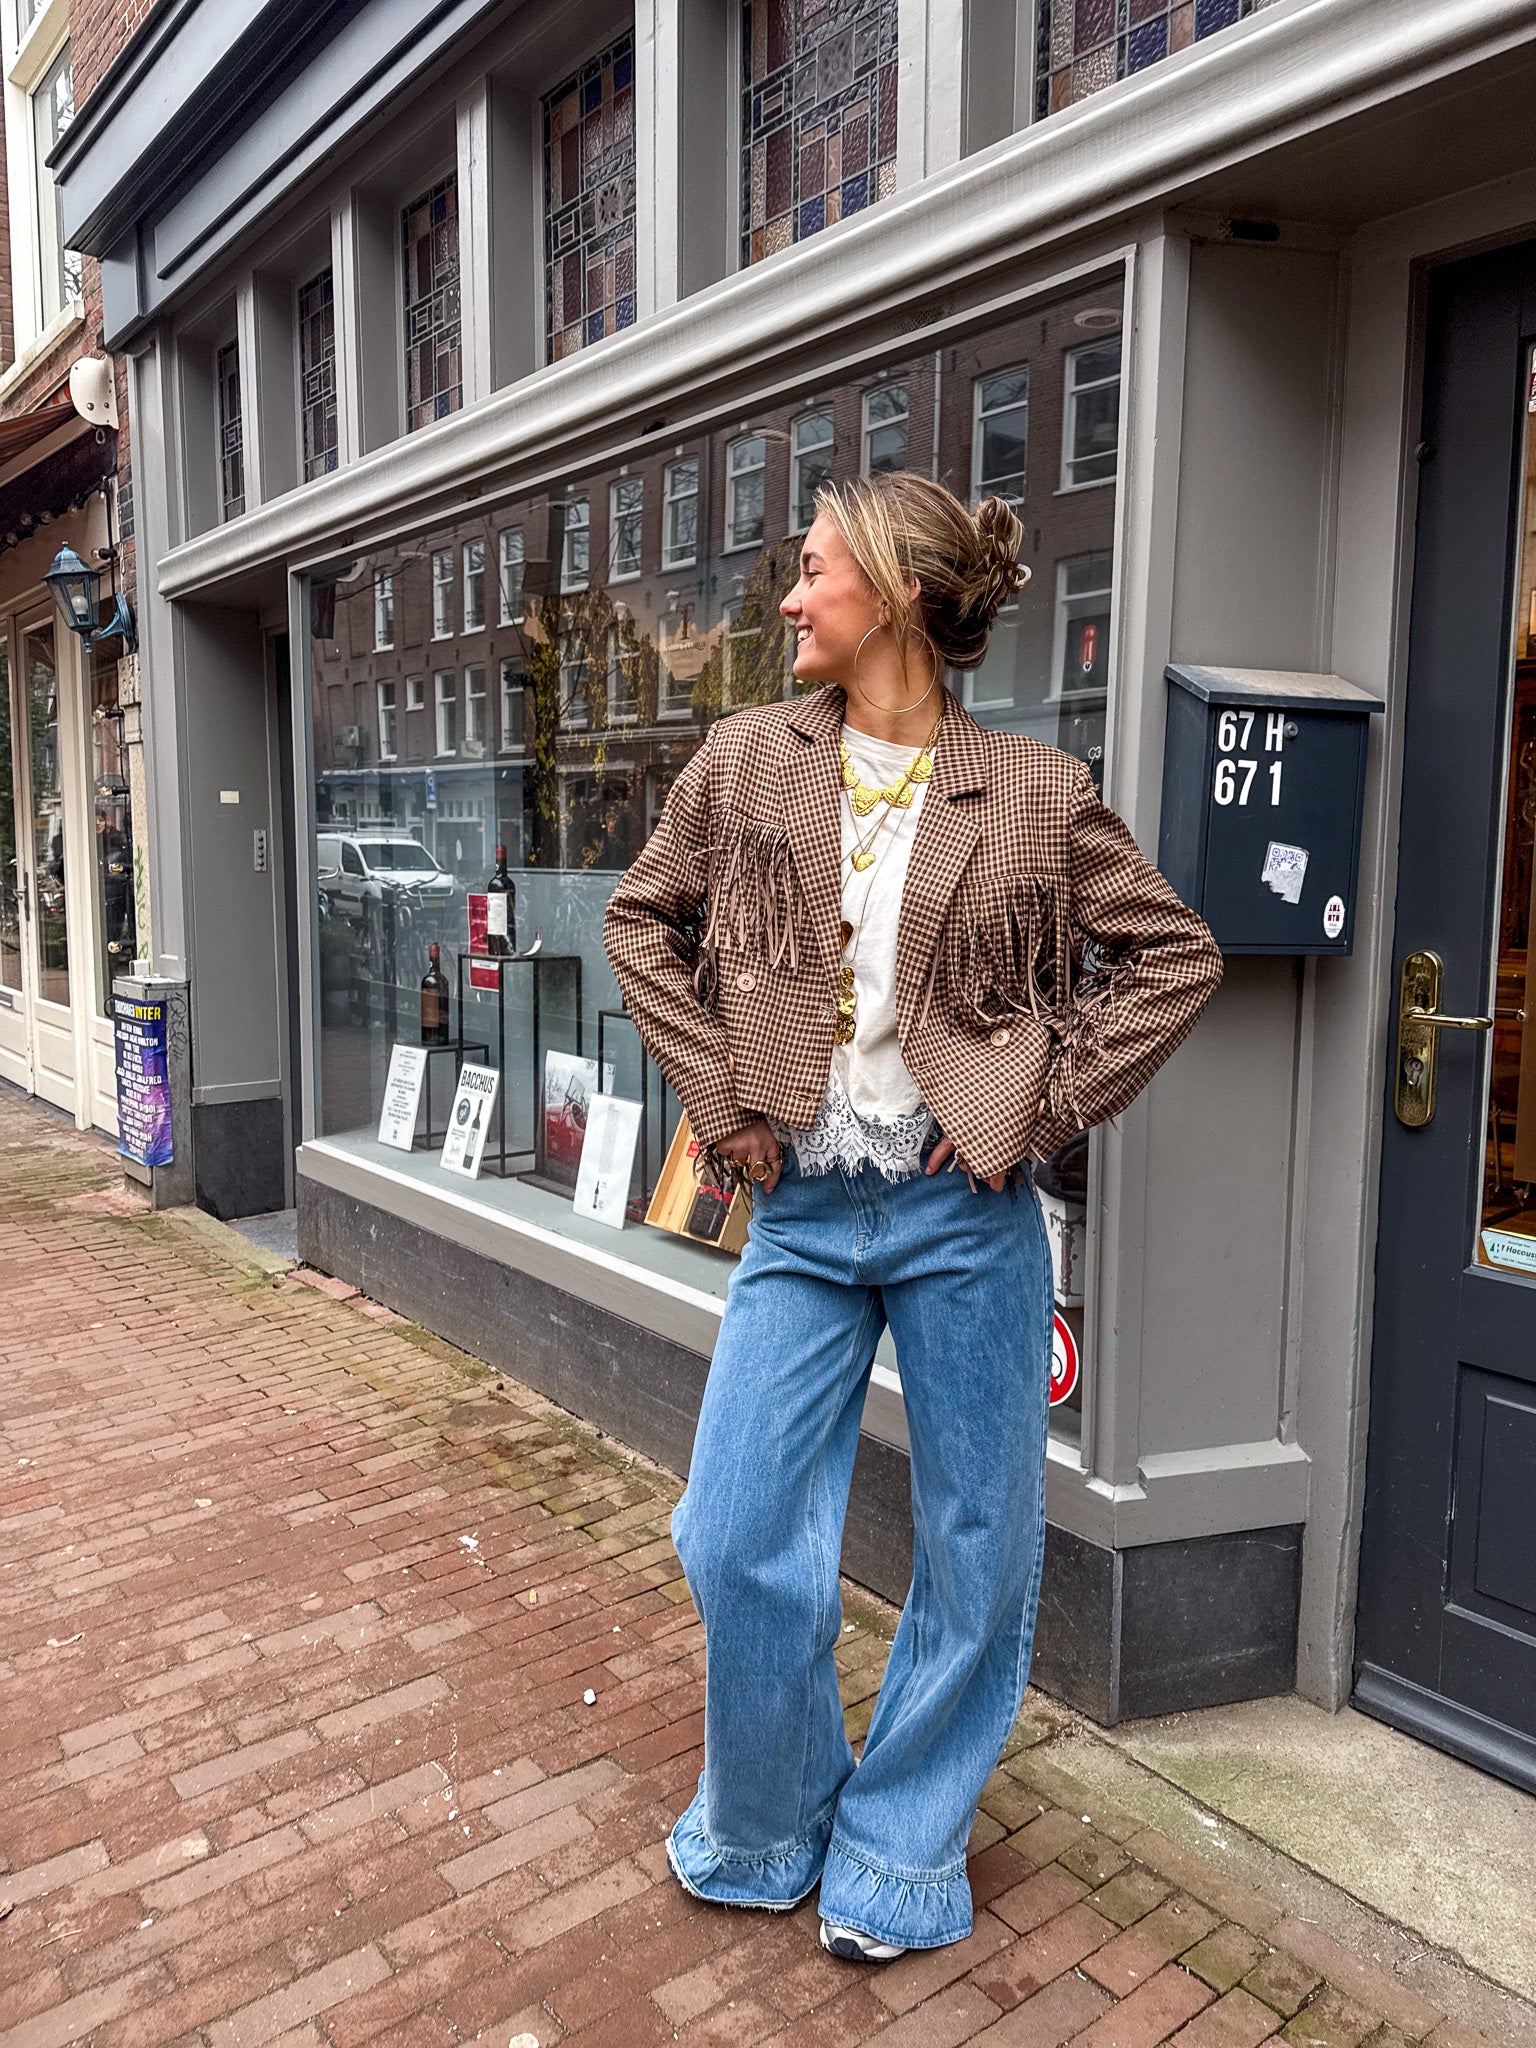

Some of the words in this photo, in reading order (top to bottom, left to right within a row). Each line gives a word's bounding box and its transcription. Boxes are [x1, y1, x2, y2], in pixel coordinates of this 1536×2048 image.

[1218, 710, 1255, 752] 67
[1265, 712, 1285, 752] H
[1214, 759, 1258, 806] 67
[1269, 760, 1282, 806] 1
[460, 1069, 495, 1094] BACCHUS
